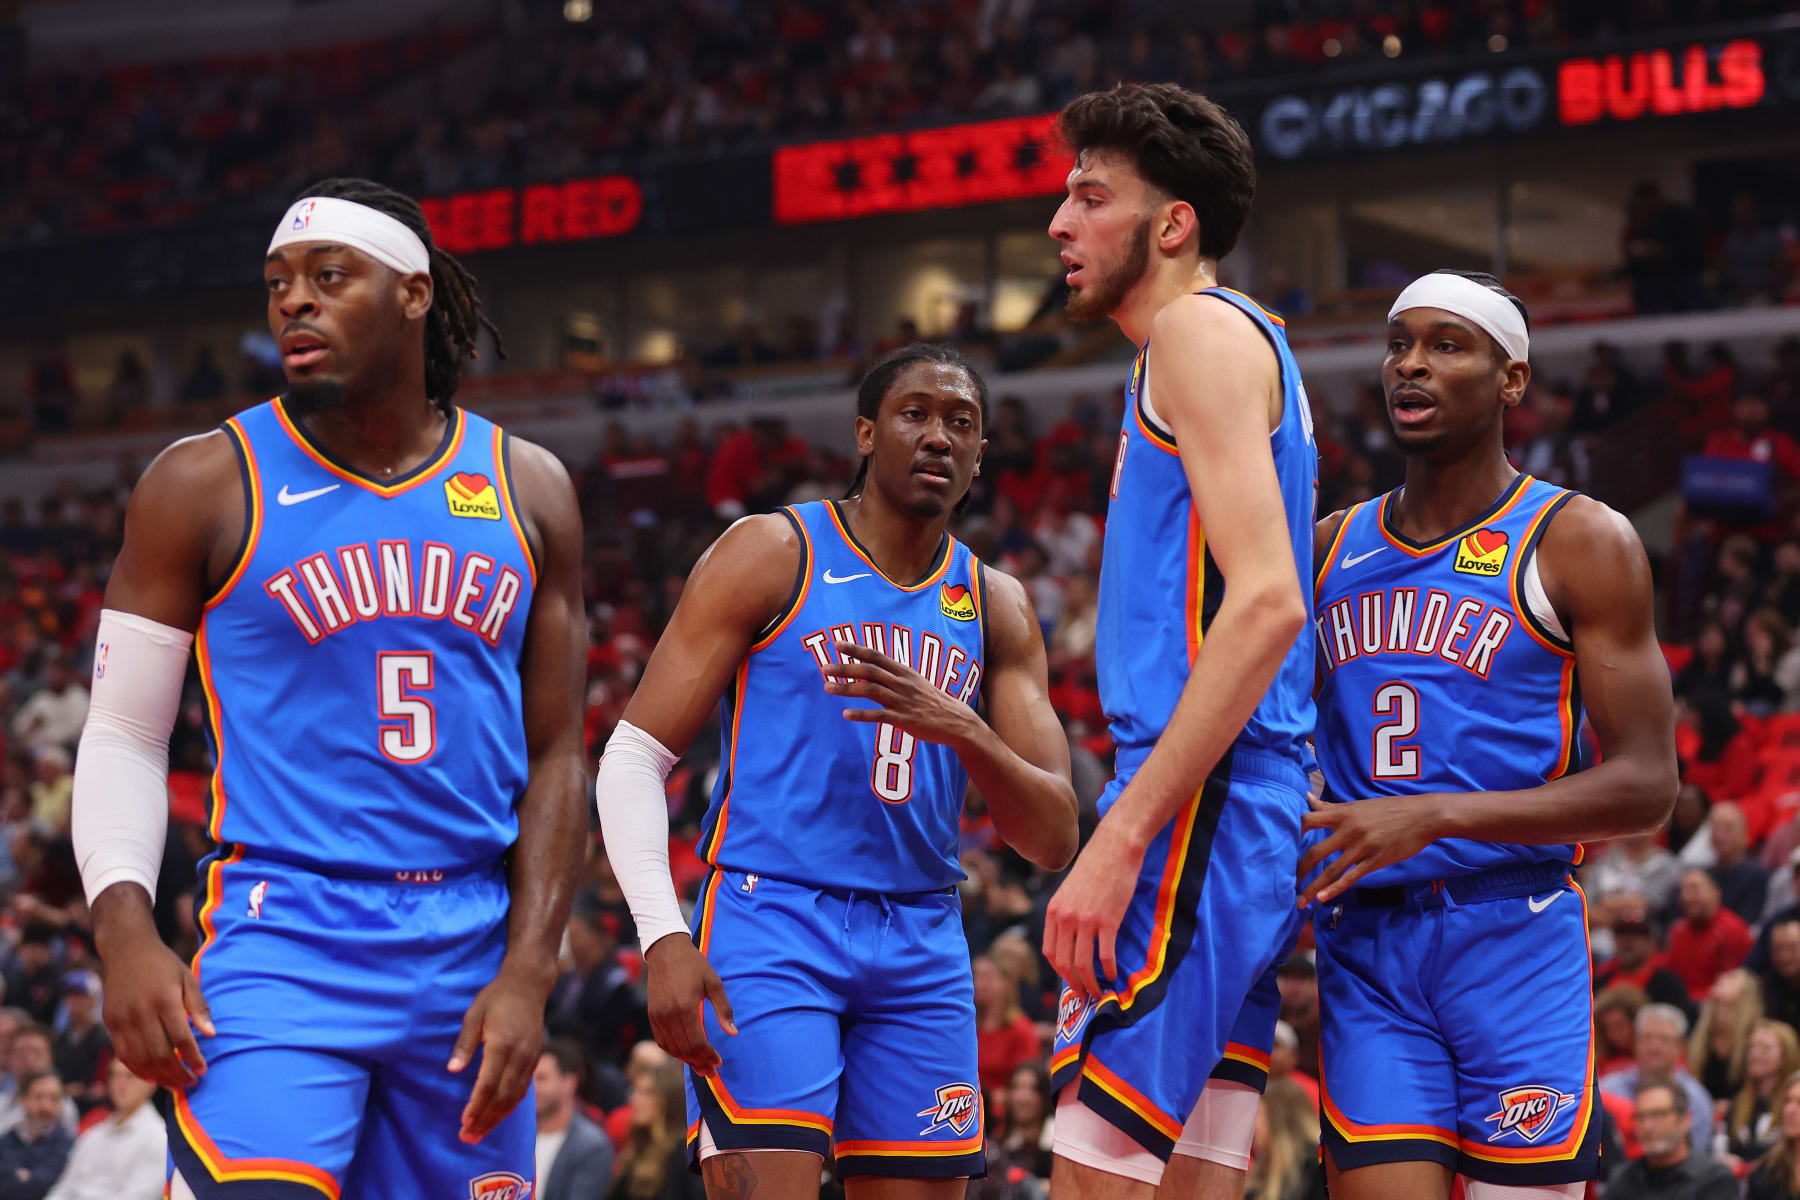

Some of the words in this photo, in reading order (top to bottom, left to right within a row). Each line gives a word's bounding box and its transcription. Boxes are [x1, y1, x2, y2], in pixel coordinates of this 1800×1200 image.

[1261, 68, 1545, 158] CHICAGO
[1558, 38, 1766, 126] BULLS
[521, 174, 643, 246] RED
[263, 539, 523, 648] THUNDER
[1315, 587, 1514, 681] THUNDER
[376, 650, 437, 765] 5
[1371, 680, 1421, 781] 2
[870, 722, 917, 804] 8
[935, 1094, 972, 1123] OKC
[1501, 1096, 1548, 1129] OKC
